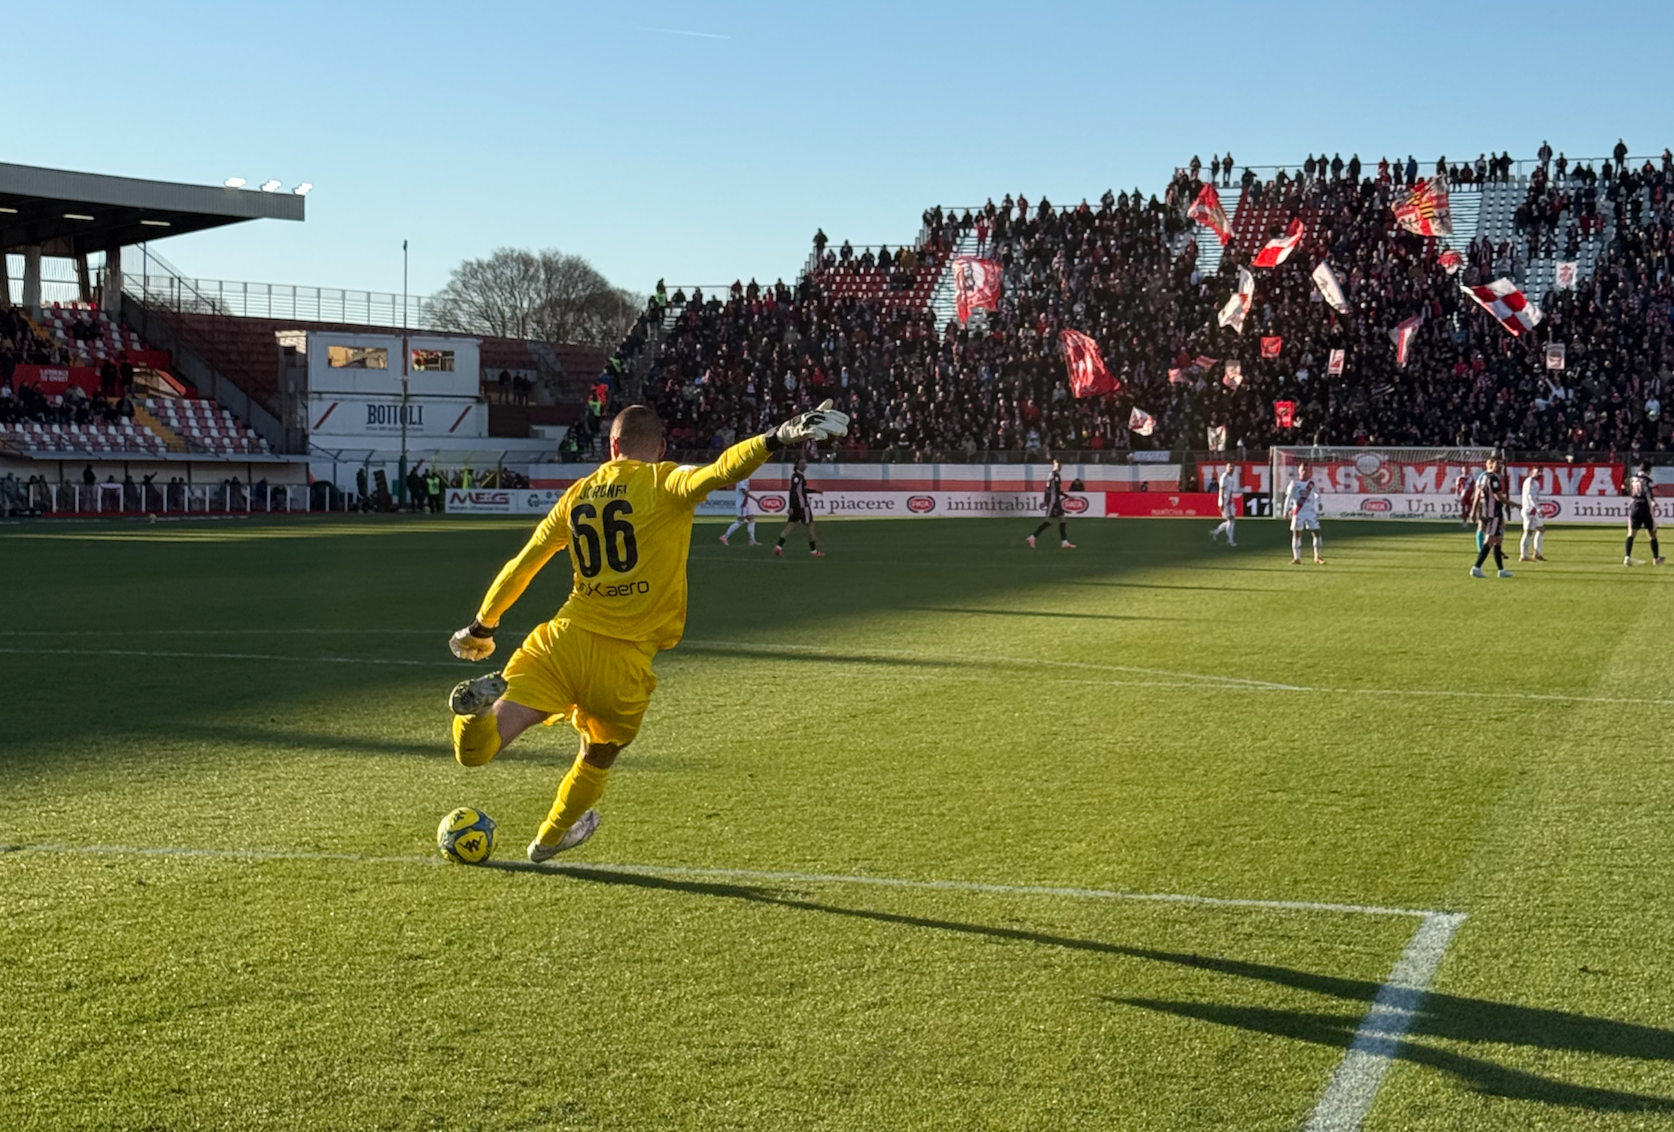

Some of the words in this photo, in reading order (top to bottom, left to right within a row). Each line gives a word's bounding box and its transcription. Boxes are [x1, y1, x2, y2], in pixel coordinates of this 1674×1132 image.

[1403, 465, 1618, 496] MATVA
[828, 495, 895, 514] piacere
[947, 496, 1048, 511] inimitabile
[1406, 499, 1435, 513] Un
[571, 500, 639, 578] 66
